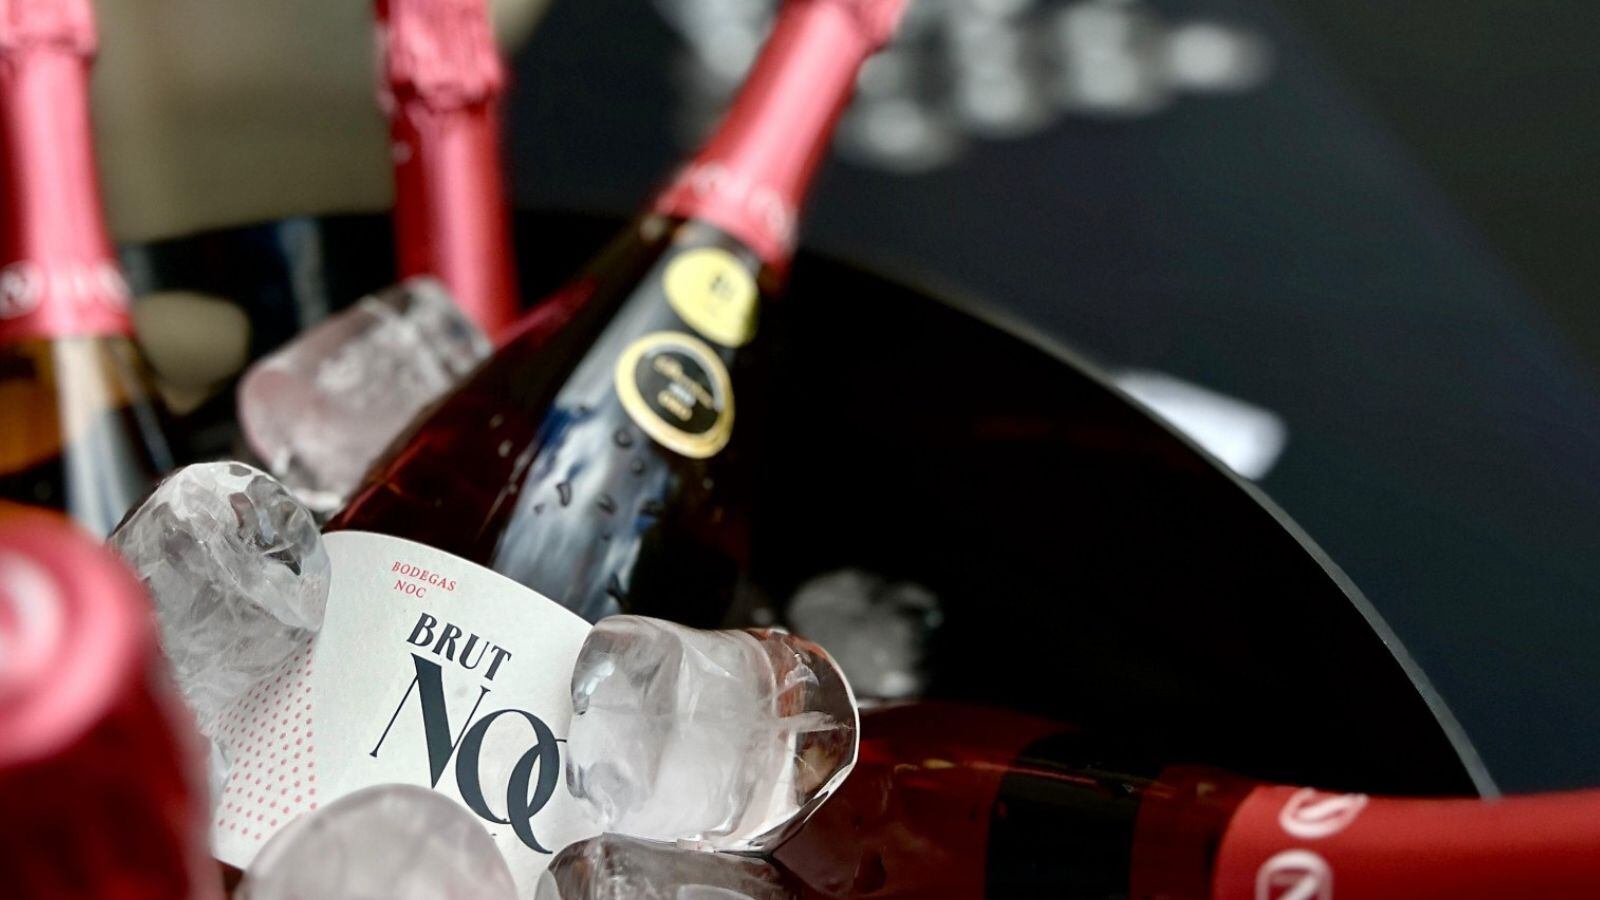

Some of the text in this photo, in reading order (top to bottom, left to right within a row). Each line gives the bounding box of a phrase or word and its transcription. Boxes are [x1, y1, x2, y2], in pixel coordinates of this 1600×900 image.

[391, 561, 457, 592] BODEGAS
[393, 579, 427, 598] NOC
[406, 612, 512, 681] BRUT
